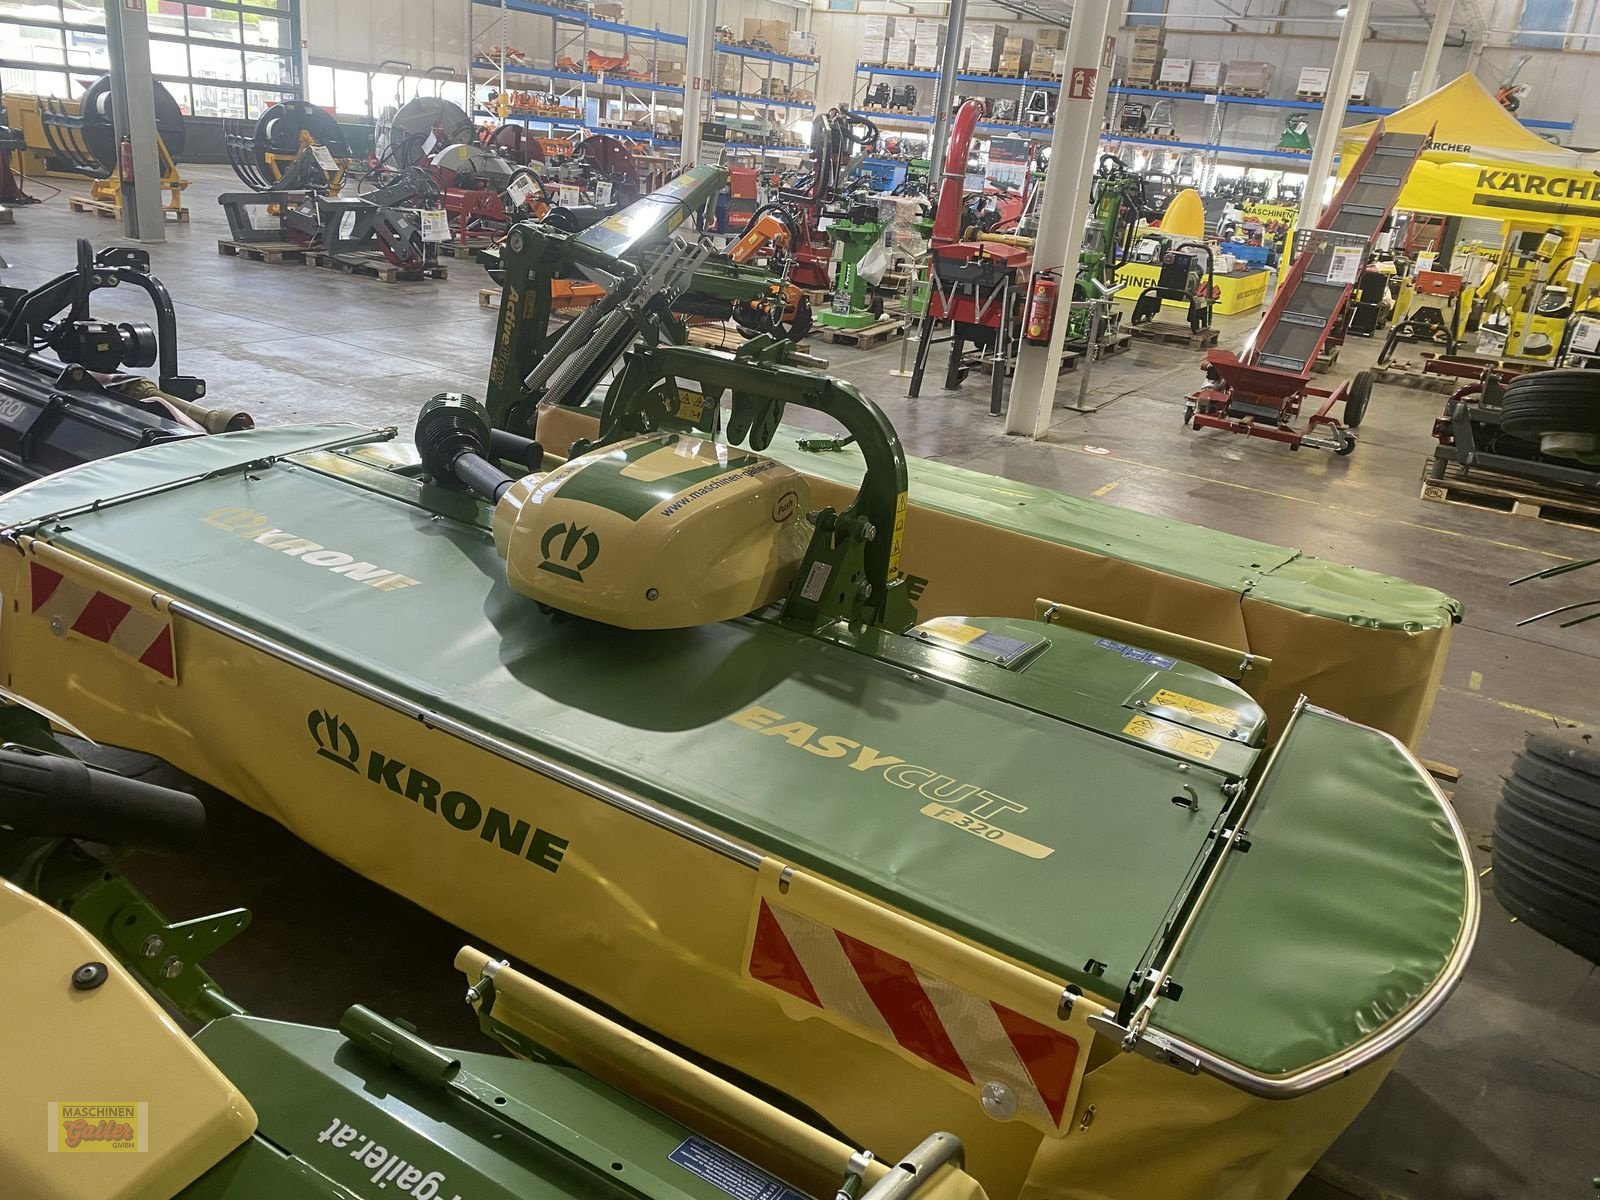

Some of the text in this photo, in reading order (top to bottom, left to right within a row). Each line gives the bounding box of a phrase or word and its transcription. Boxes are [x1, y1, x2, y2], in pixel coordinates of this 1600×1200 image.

[661, 461, 779, 517] www.maschinen-gailer.at
[254, 528, 423, 592] KRONE
[728, 705, 1029, 820] EASYCUT
[367, 751, 570, 874] KRONE
[953, 816, 1005, 839] 320
[317, 1117, 462, 1200] -gailer.at
